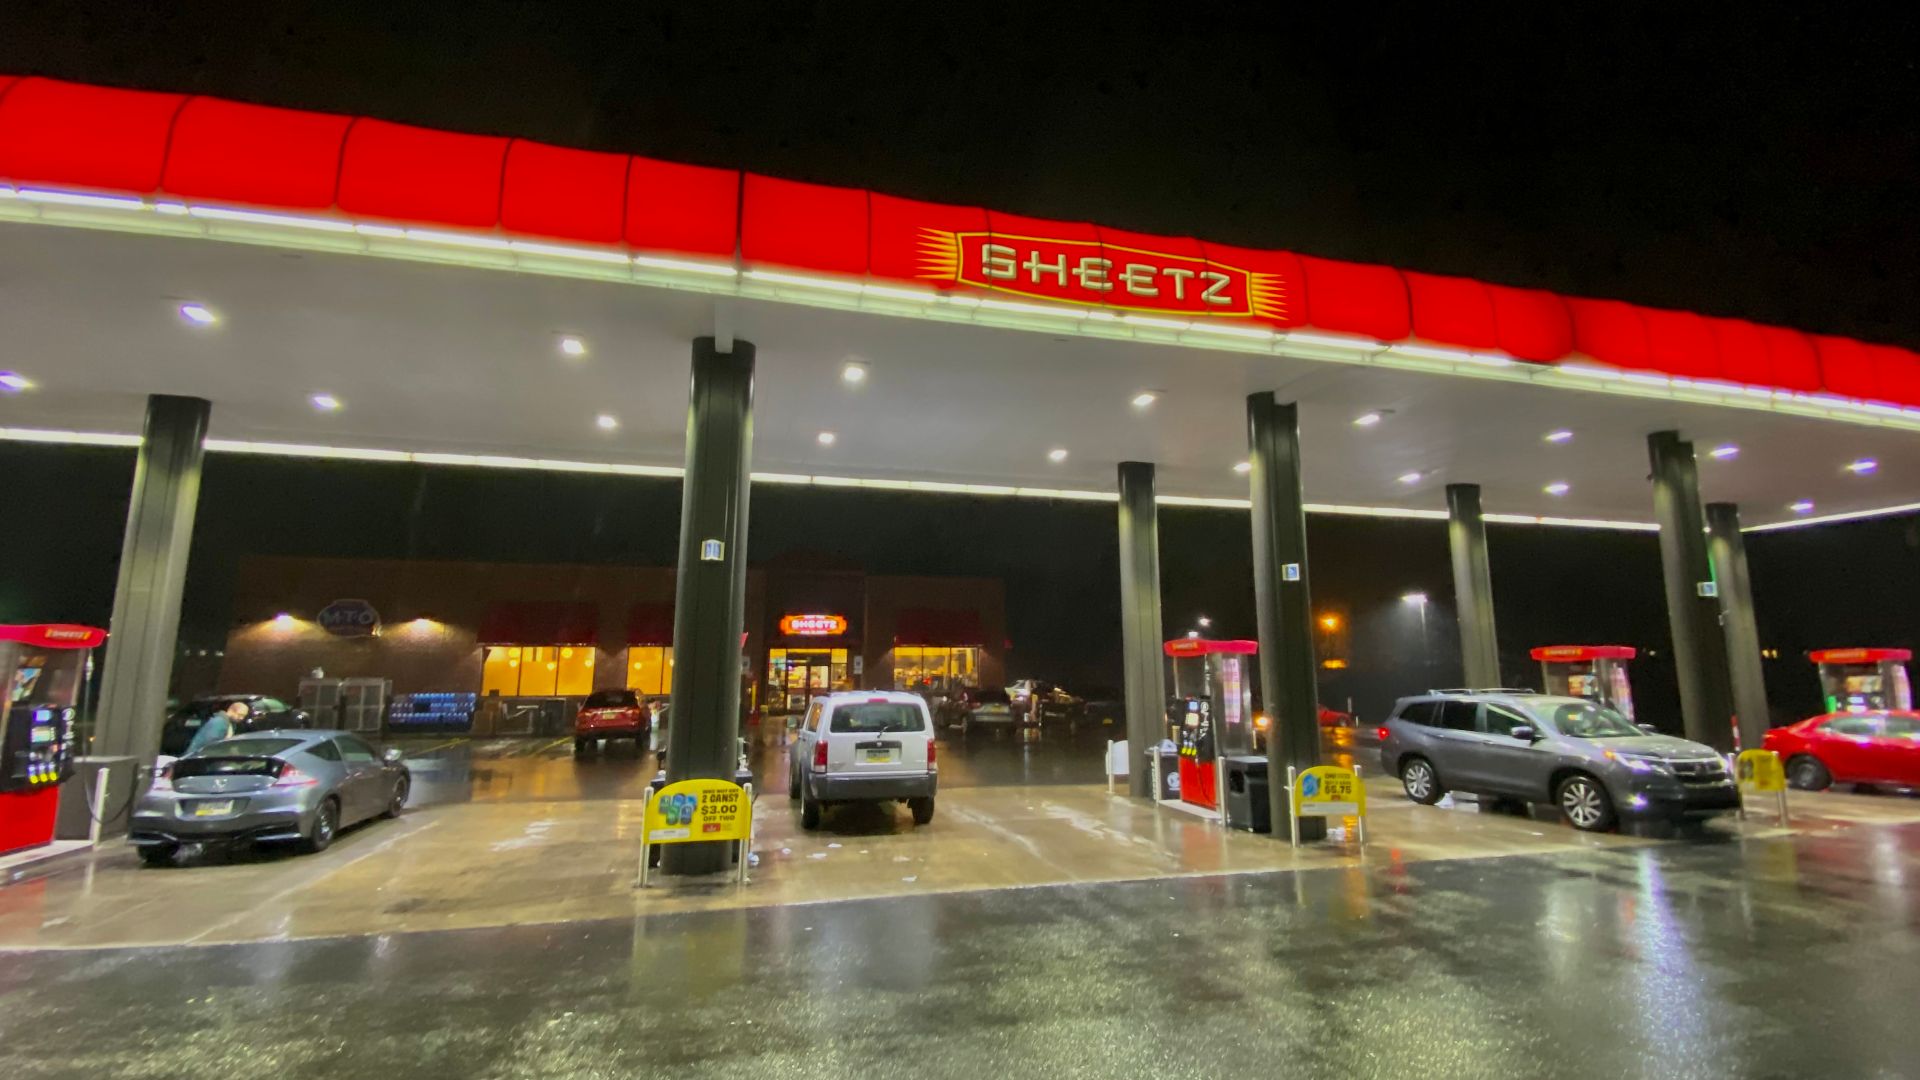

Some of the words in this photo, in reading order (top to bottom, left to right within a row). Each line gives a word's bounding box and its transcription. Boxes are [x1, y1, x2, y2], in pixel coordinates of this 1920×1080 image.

[981, 243, 1233, 306] SHEETZ
[702, 794, 708, 803] 2
[710, 793, 739, 803] CANS?
[701, 805, 738, 815] $3.00
